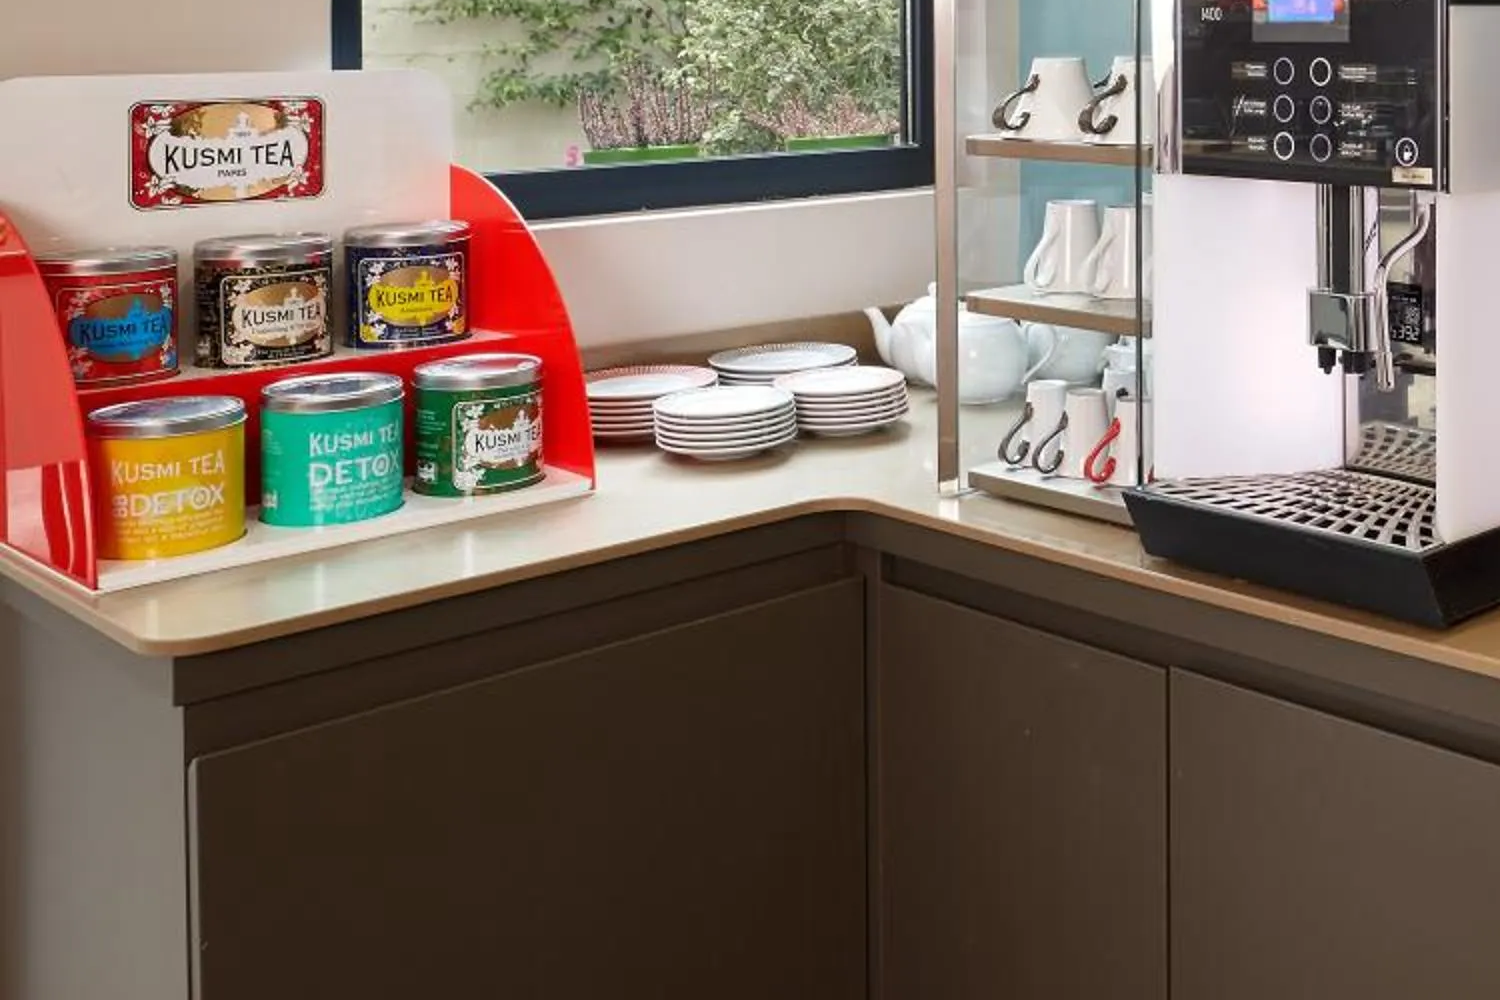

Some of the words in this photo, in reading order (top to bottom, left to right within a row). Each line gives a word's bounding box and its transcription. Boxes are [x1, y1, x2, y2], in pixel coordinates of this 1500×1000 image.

[164, 143, 242, 174] KUSMI
[249, 140, 294, 168] TEA
[217, 168, 248, 178] PARIS
[376, 289, 425, 308] KUSMI
[429, 285, 453, 303] TEA
[241, 308, 294, 329] KUSMI
[79, 322, 137, 344] KUSMI
[309, 431, 373, 457] KUSMI
[474, 431, 520, 454] KUSMI
[111, 458, 181, 487] KUSMI
[188, 448, 225, 476] TEA
[308, 449, 400, 488] DETOX
[129, 481, 225, 518] DETOX
